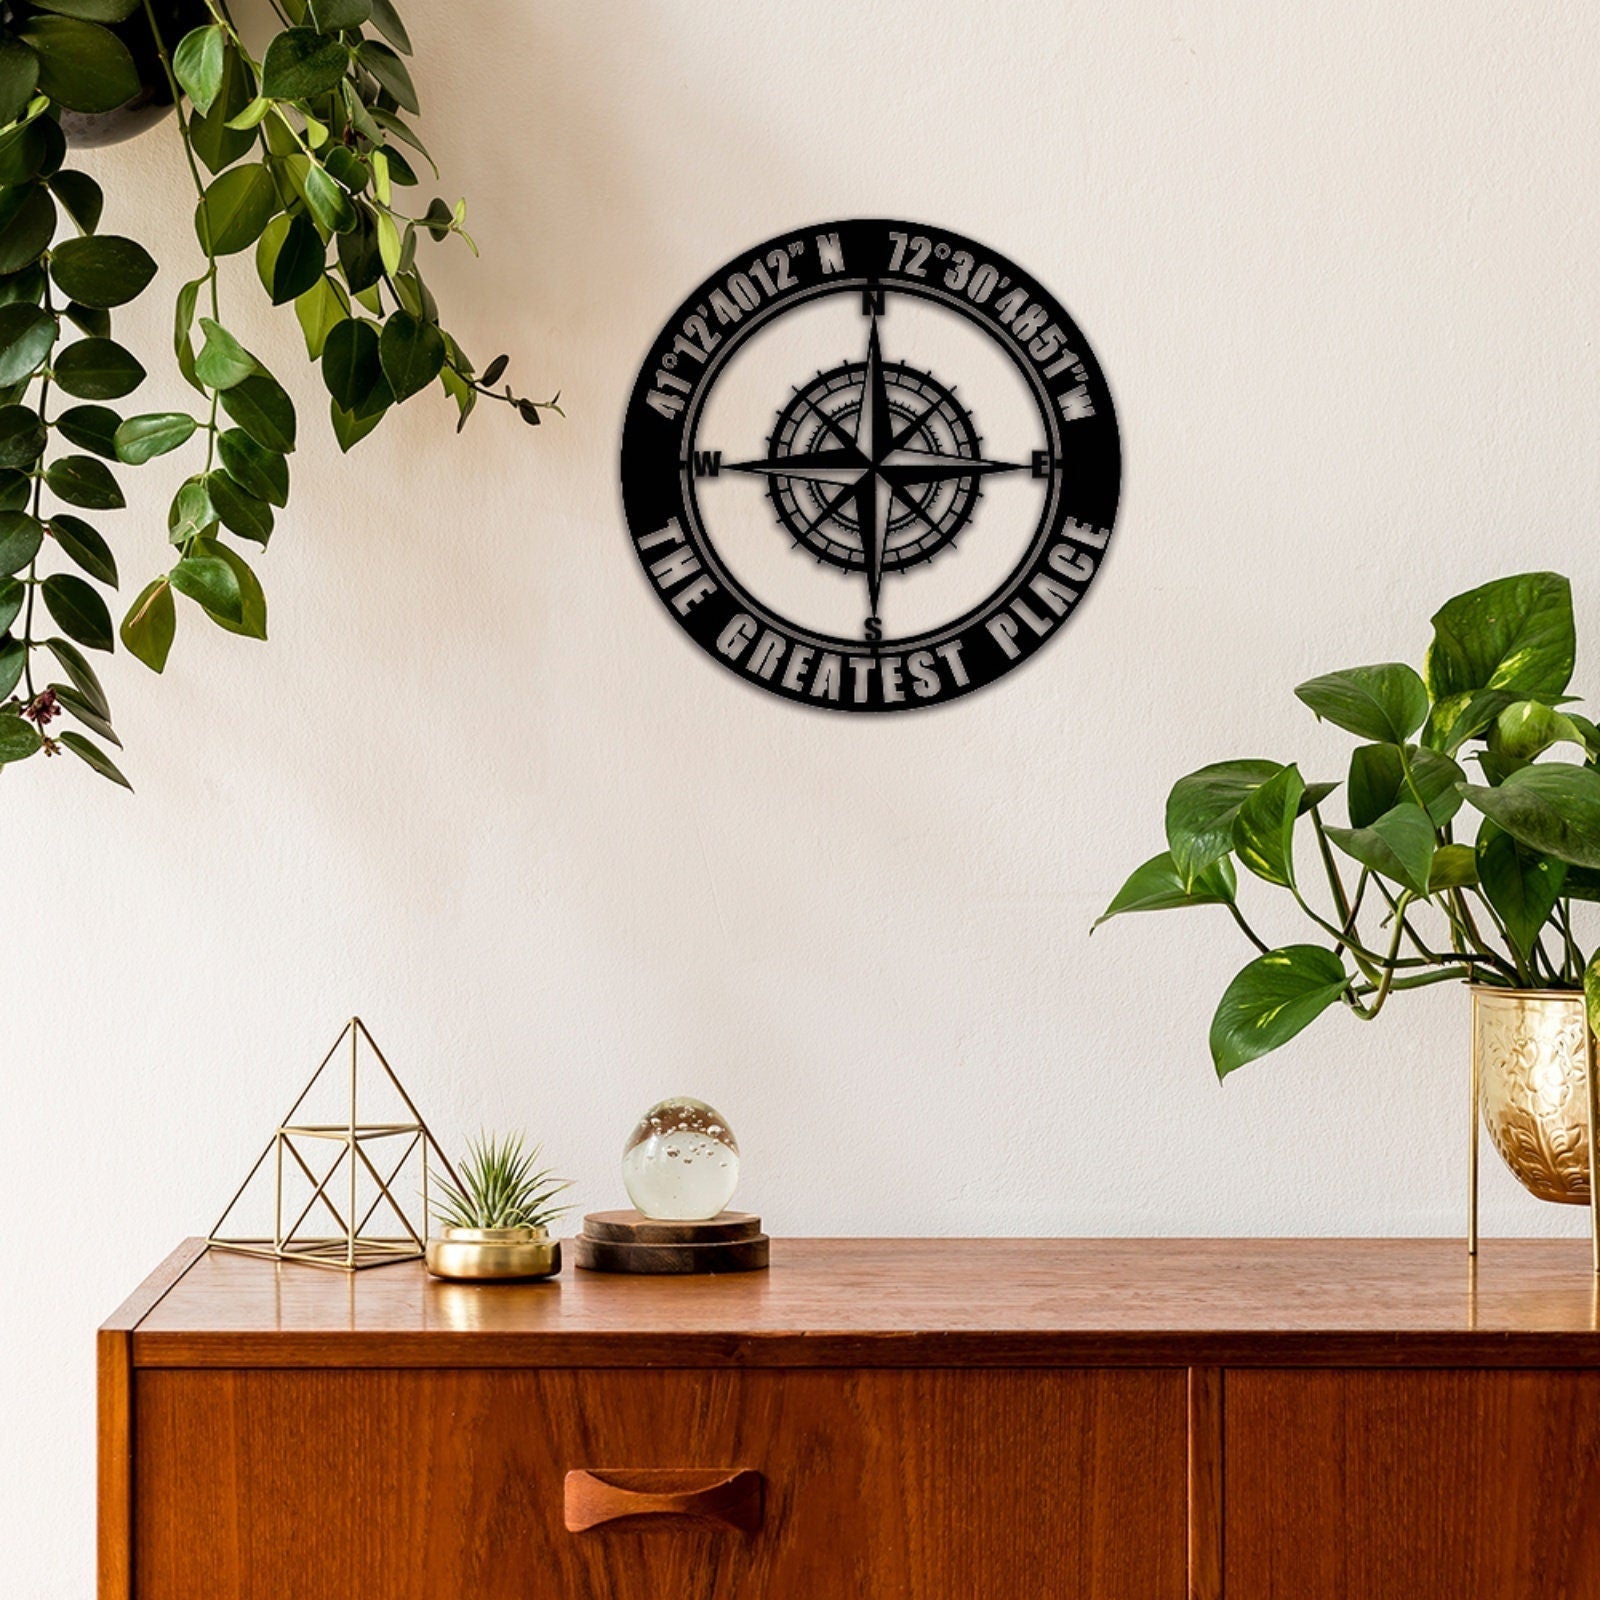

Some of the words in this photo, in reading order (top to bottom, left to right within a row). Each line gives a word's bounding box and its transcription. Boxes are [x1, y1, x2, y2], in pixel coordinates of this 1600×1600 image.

[815, 232, 845, 275] N
[862, 291, 885, 315] N
[693, 451, 722, 477] W
[1032, 450, 1050, 478] E
[637, 516, 718, 617] THE
[716, 613, 970, 704] GREATEST
[985, 515, 1111, 660] PLACE
[864, 617, 882, 641] S
